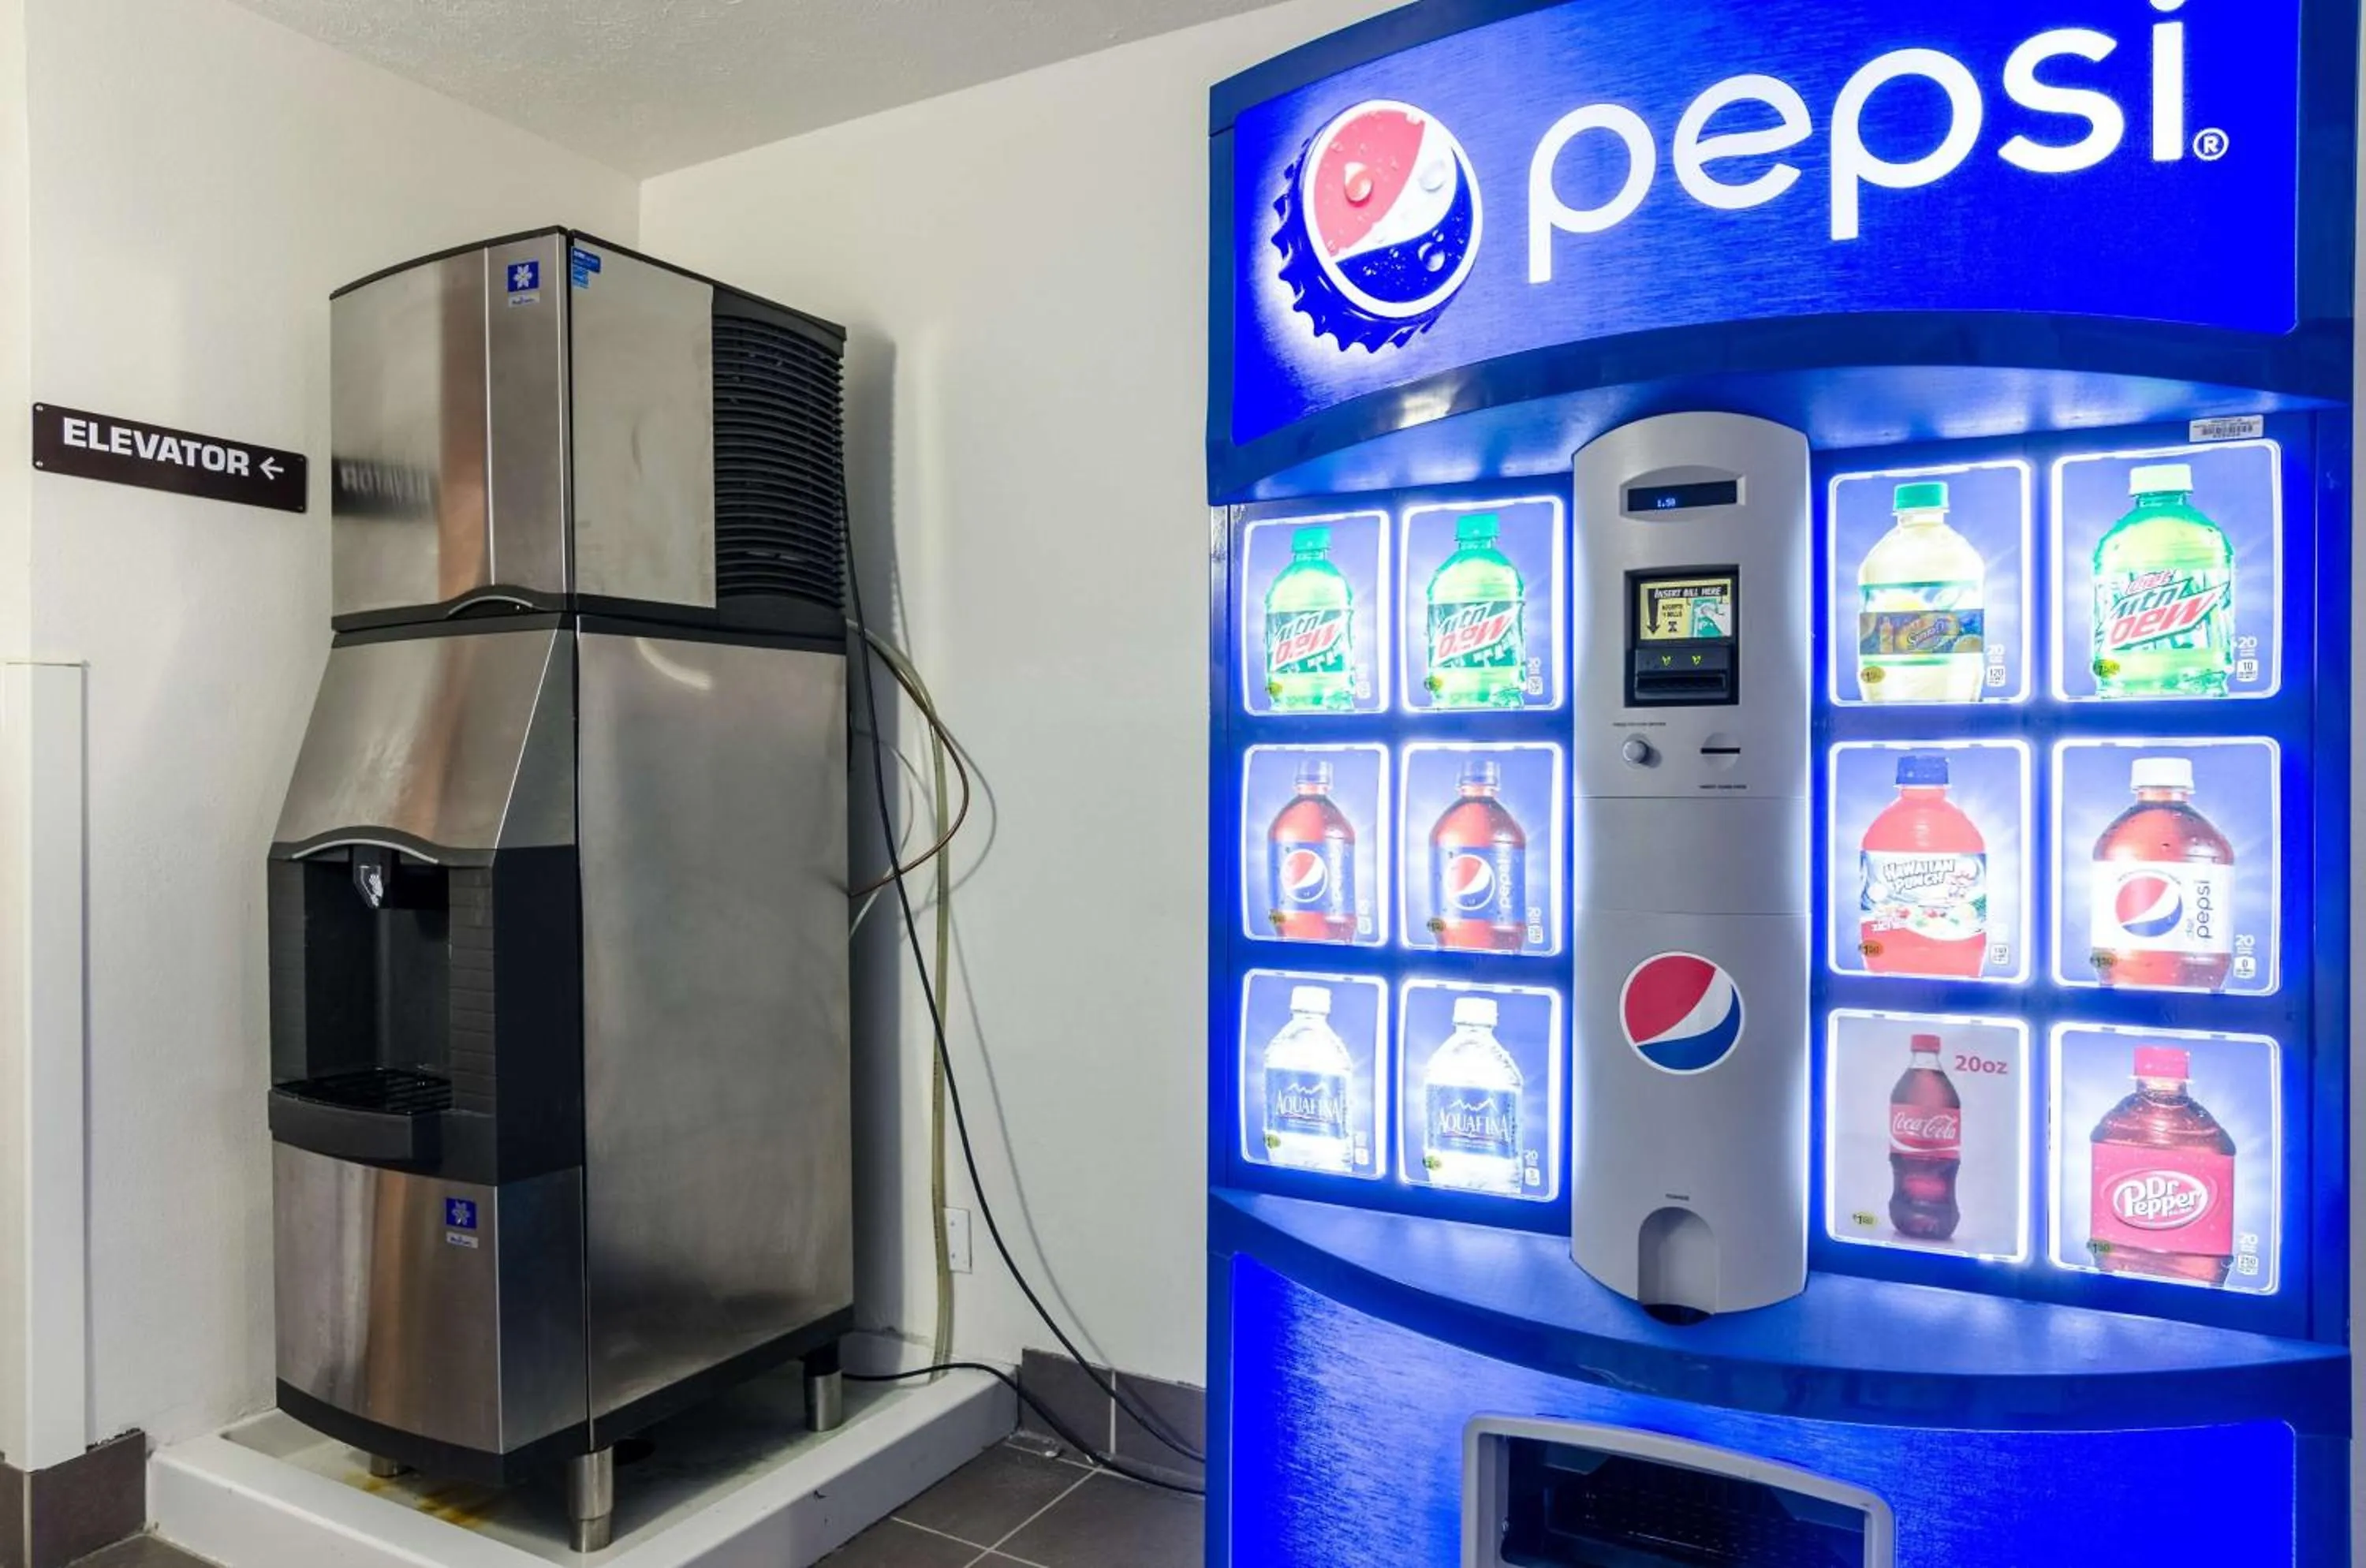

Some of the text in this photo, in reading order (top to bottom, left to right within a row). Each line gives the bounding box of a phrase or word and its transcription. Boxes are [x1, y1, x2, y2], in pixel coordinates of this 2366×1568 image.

[1528, 0, 2184, 282] pepsi
[63, 416, 249, 476] ELEVATOR
[1655, 586, 1722, 599] INSERT BILL HERE
[2237, 637, 2257, 648] 20
[2243, 662, 2253, 670] 10
[1883, 858, 1956, 882] HAWAIIAN
[1894, 871, 1946, 894] PUNCH
[2194, 879, 2213, 939] pepsi
[2235, 935, 2256, 946] 20
[1954, 1055, 2008, 1074] 20oz
[1438, 1107, 1510, 1144] AQUAFINA
[2124, 1180, 2203, 1219] Pepper
[2146, 1176, 2179, 1200] Dr
